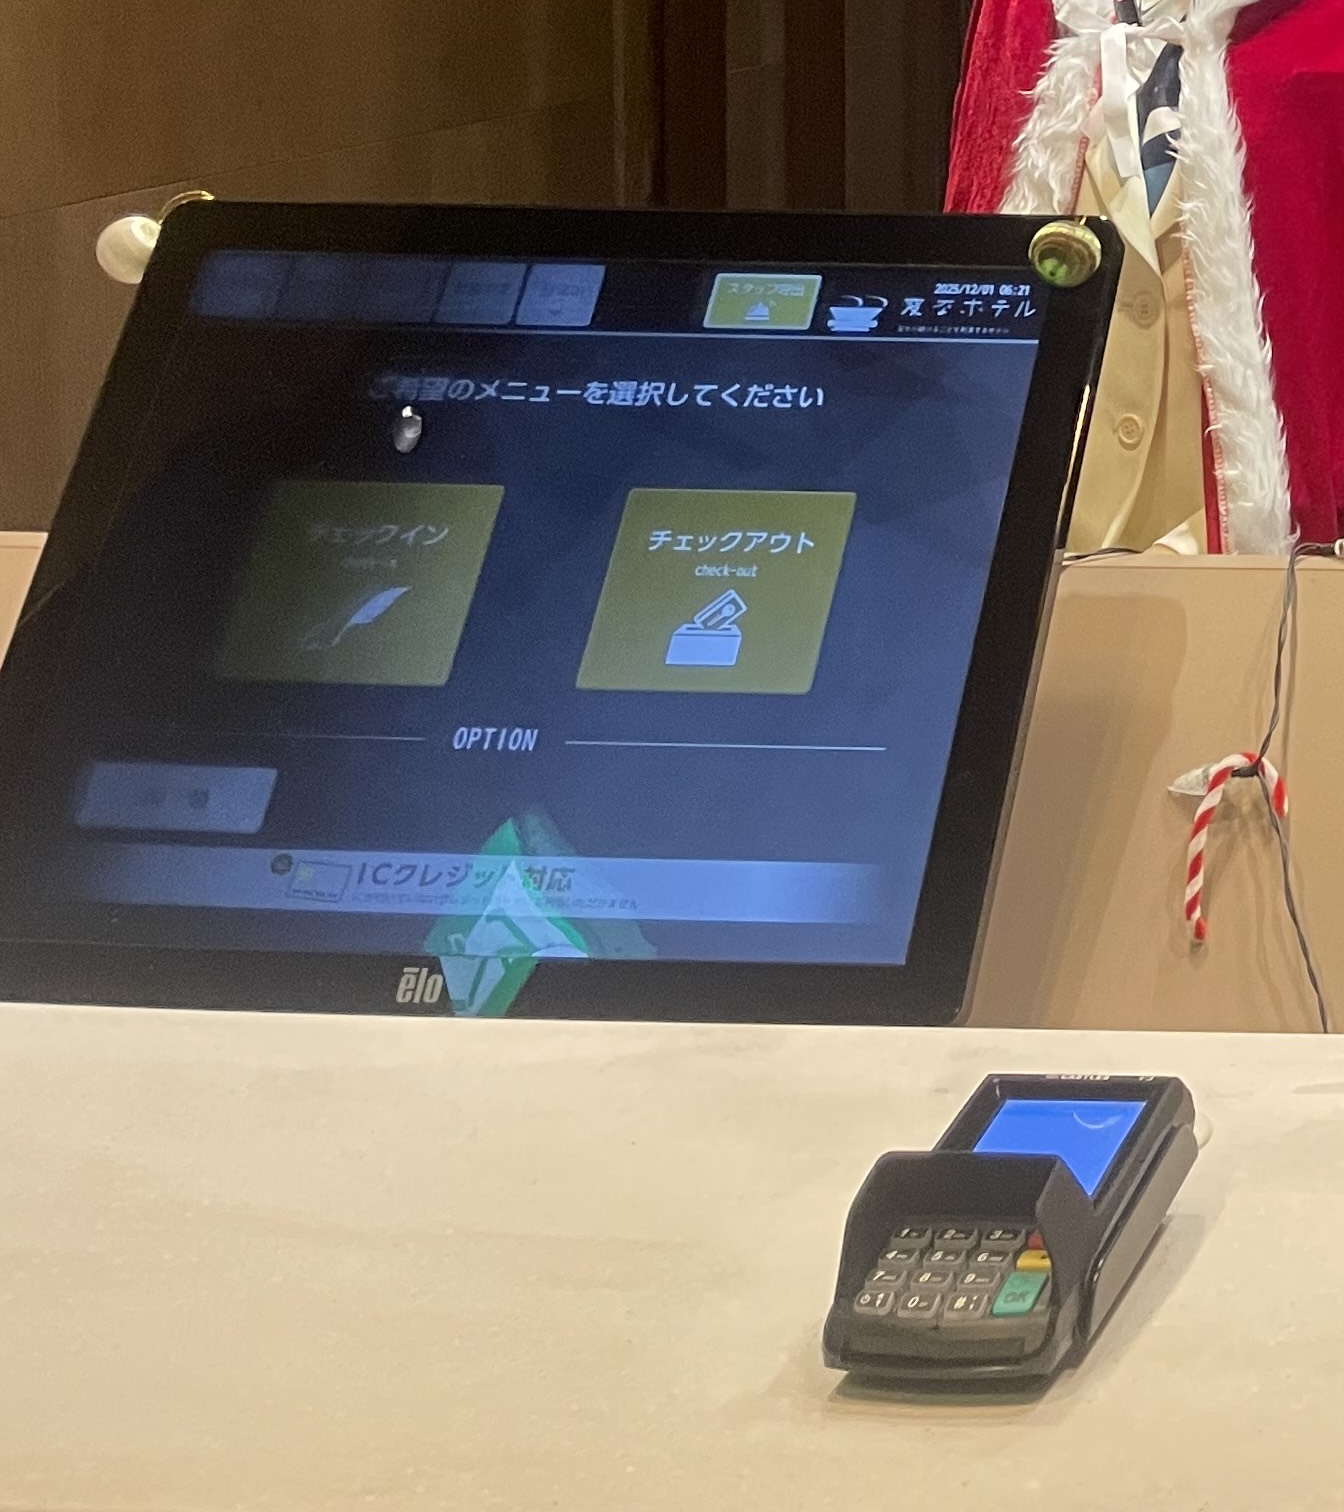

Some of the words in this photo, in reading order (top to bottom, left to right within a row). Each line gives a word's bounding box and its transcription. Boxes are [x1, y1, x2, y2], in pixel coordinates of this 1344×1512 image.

[901, 297, 1036, 319] 変なホテル
[648, 529, 815, 554] チェックアウト
[694, 562, 758, 579] check-out
[452, 726, 540, 753] OPTION
[1004, 1292, 1028, 1304] OK
